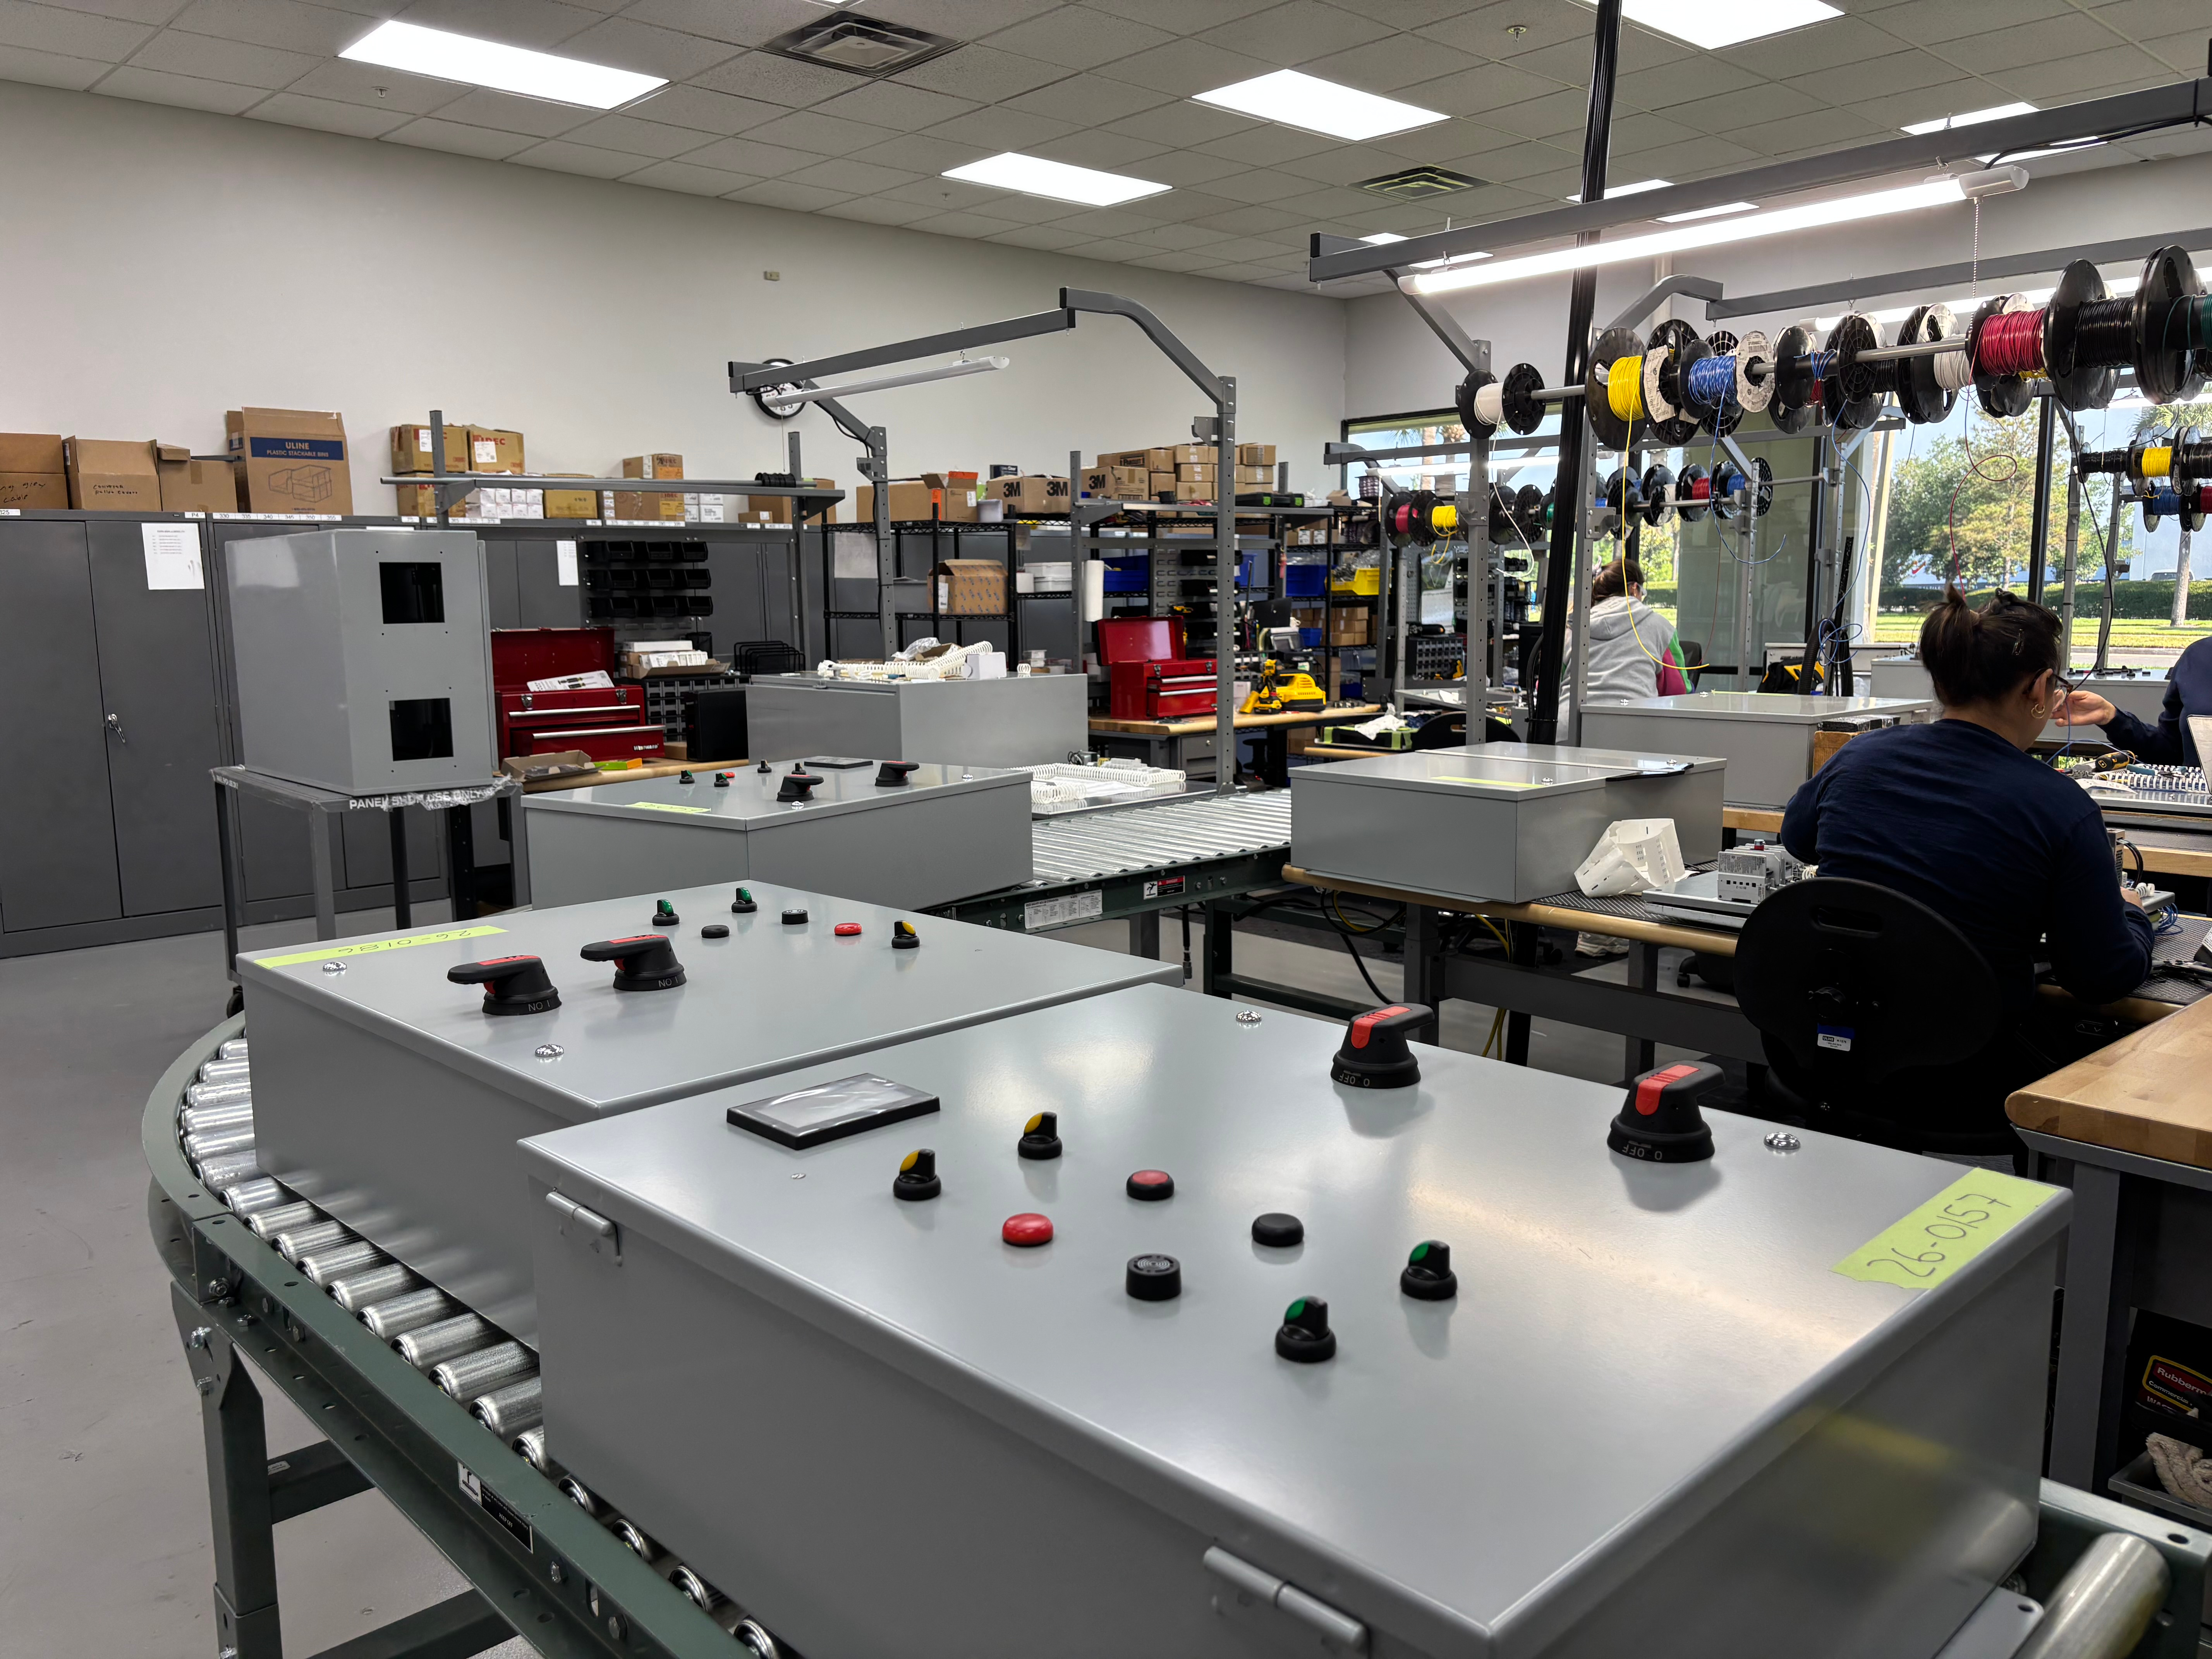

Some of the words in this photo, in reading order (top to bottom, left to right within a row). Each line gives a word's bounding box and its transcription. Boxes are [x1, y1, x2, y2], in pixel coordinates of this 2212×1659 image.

[1047, 481, 1068, 496] 3M
[1089, 474, 1105, 489] 3M
[1003, 482, 1021, 498] 3M
[1339, 1073, 1355, 1084] OFF
[1622, 1144, 1645, 1157] OFF
[1866, 1194, 2012, 1278] 26-0157
[2157, 1367, 2207, 1395] Rubberm
